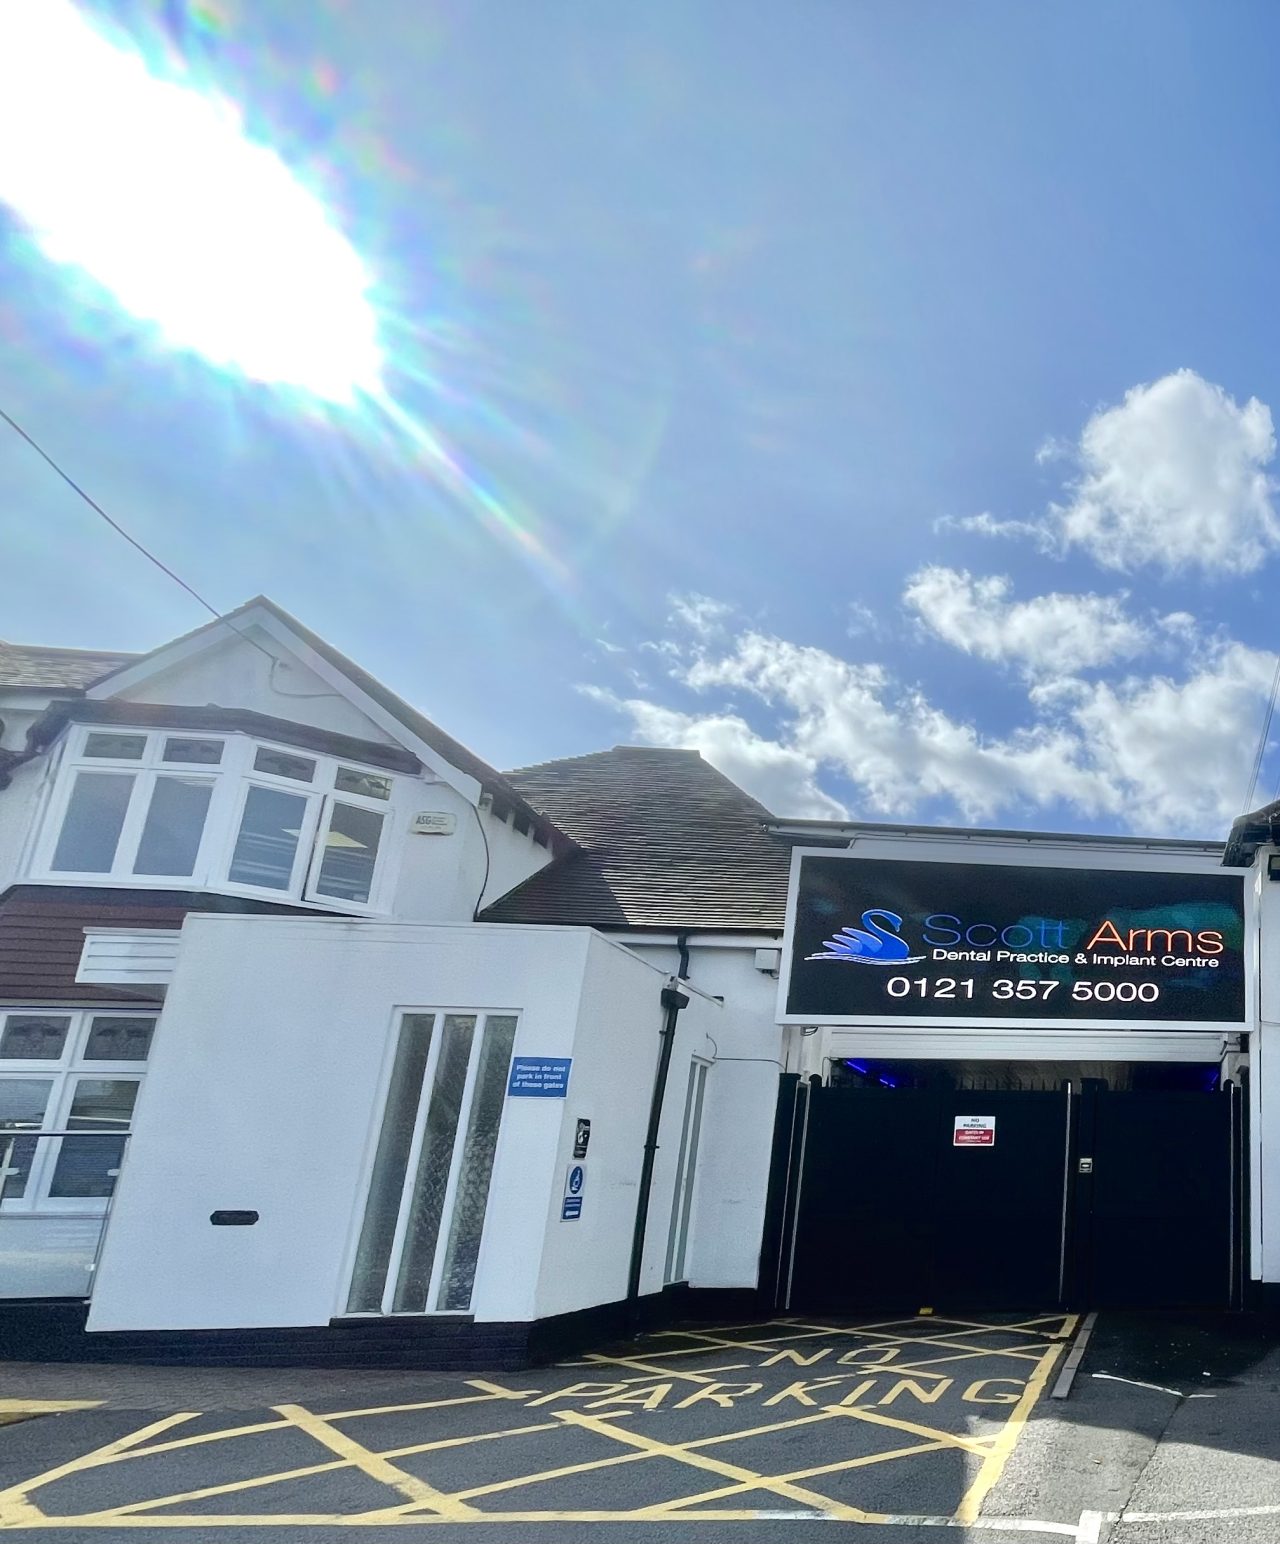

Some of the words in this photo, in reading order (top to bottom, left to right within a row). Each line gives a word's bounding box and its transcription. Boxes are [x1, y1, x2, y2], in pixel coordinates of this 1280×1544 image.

[922, 914, 1069, 949] Scott
[1087, 920, 1224, 954] Arms
[932, 949, 991, 962] Dental
[997, 951, 1069, 964] Practice
[1074, 953, 1088, 965] &
[1093, 954, 1156, 967] Implant
[1161, 955, 1219, 968] Centre
[886, 977, 975, 999] 0121
[992, 980, 1060, 1000] 357
[1071, 981, 1160, 1002] 5000
[758, 1347, 901, 1367] NO
[524, 1376, 1023, 1409] PARKING
